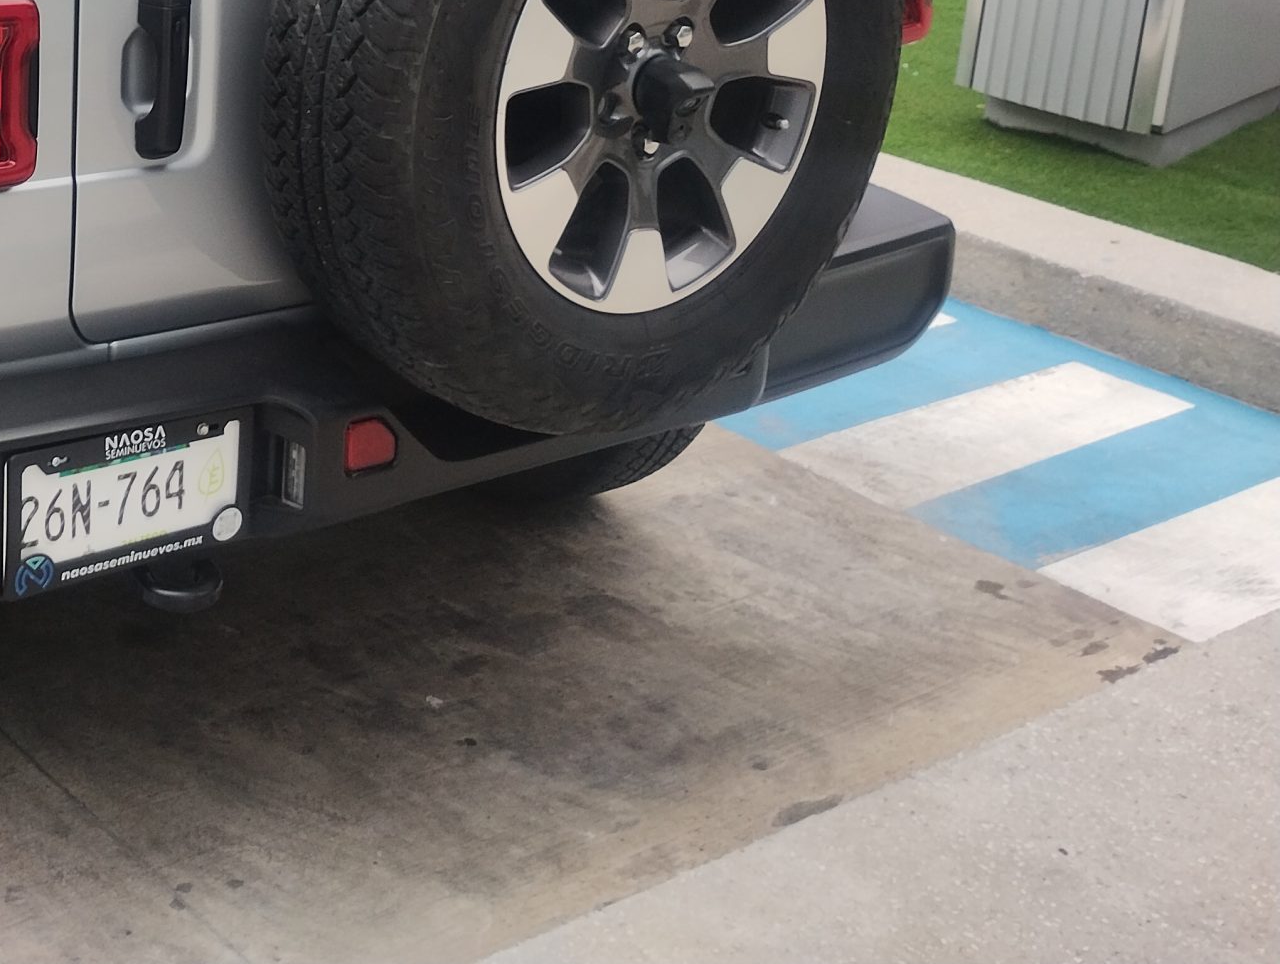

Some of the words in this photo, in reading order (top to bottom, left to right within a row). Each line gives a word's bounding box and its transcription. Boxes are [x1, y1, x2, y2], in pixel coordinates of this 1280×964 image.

[104, 424, 167, 452] NAOSA
[104, 437, 167, 461] SEMINUEVOS
[20, 459, 185, 550] 26N-764
[60, 534, 204, 582] naosaseminuevos.mx
